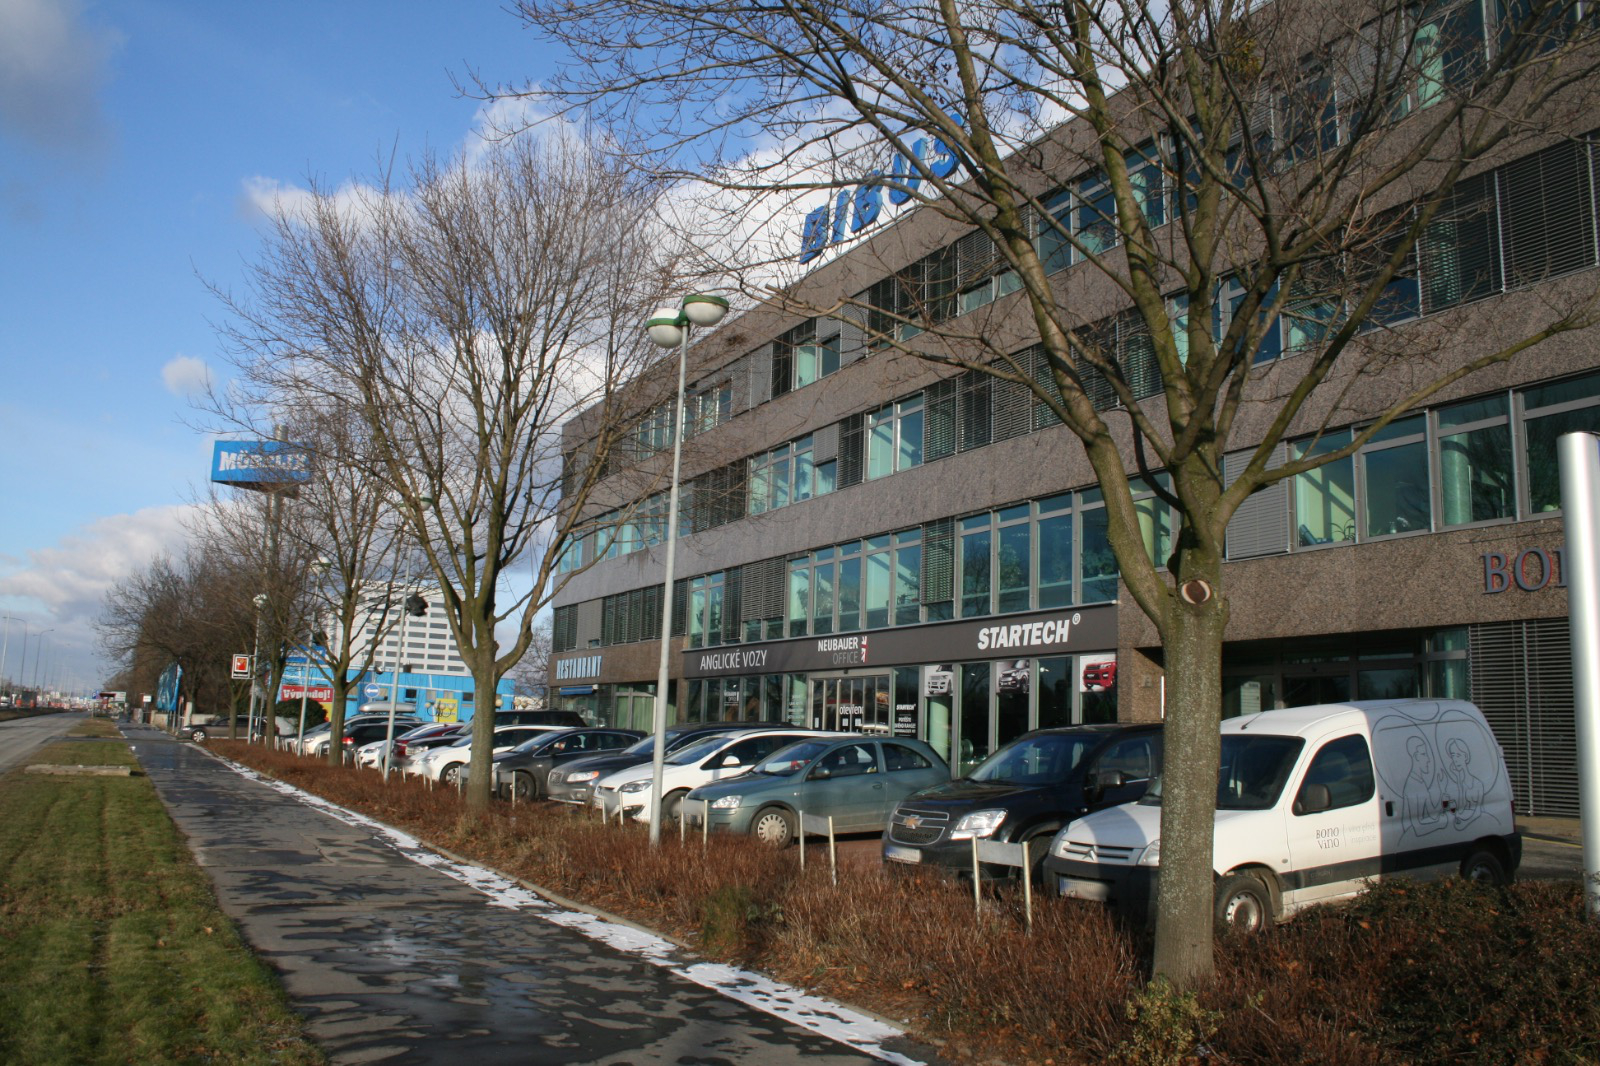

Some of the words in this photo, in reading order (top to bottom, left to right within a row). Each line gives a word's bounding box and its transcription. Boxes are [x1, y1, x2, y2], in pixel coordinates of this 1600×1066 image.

[817, 636, 859, 652] NEUBAUER
[556, 655, 602, 680] RESTAURANT
[699, 649, 740, 671] ANGLICKÉ
[742, 649, 768, 668] VOZY
[832, 651, 859, 665] OFFICE
